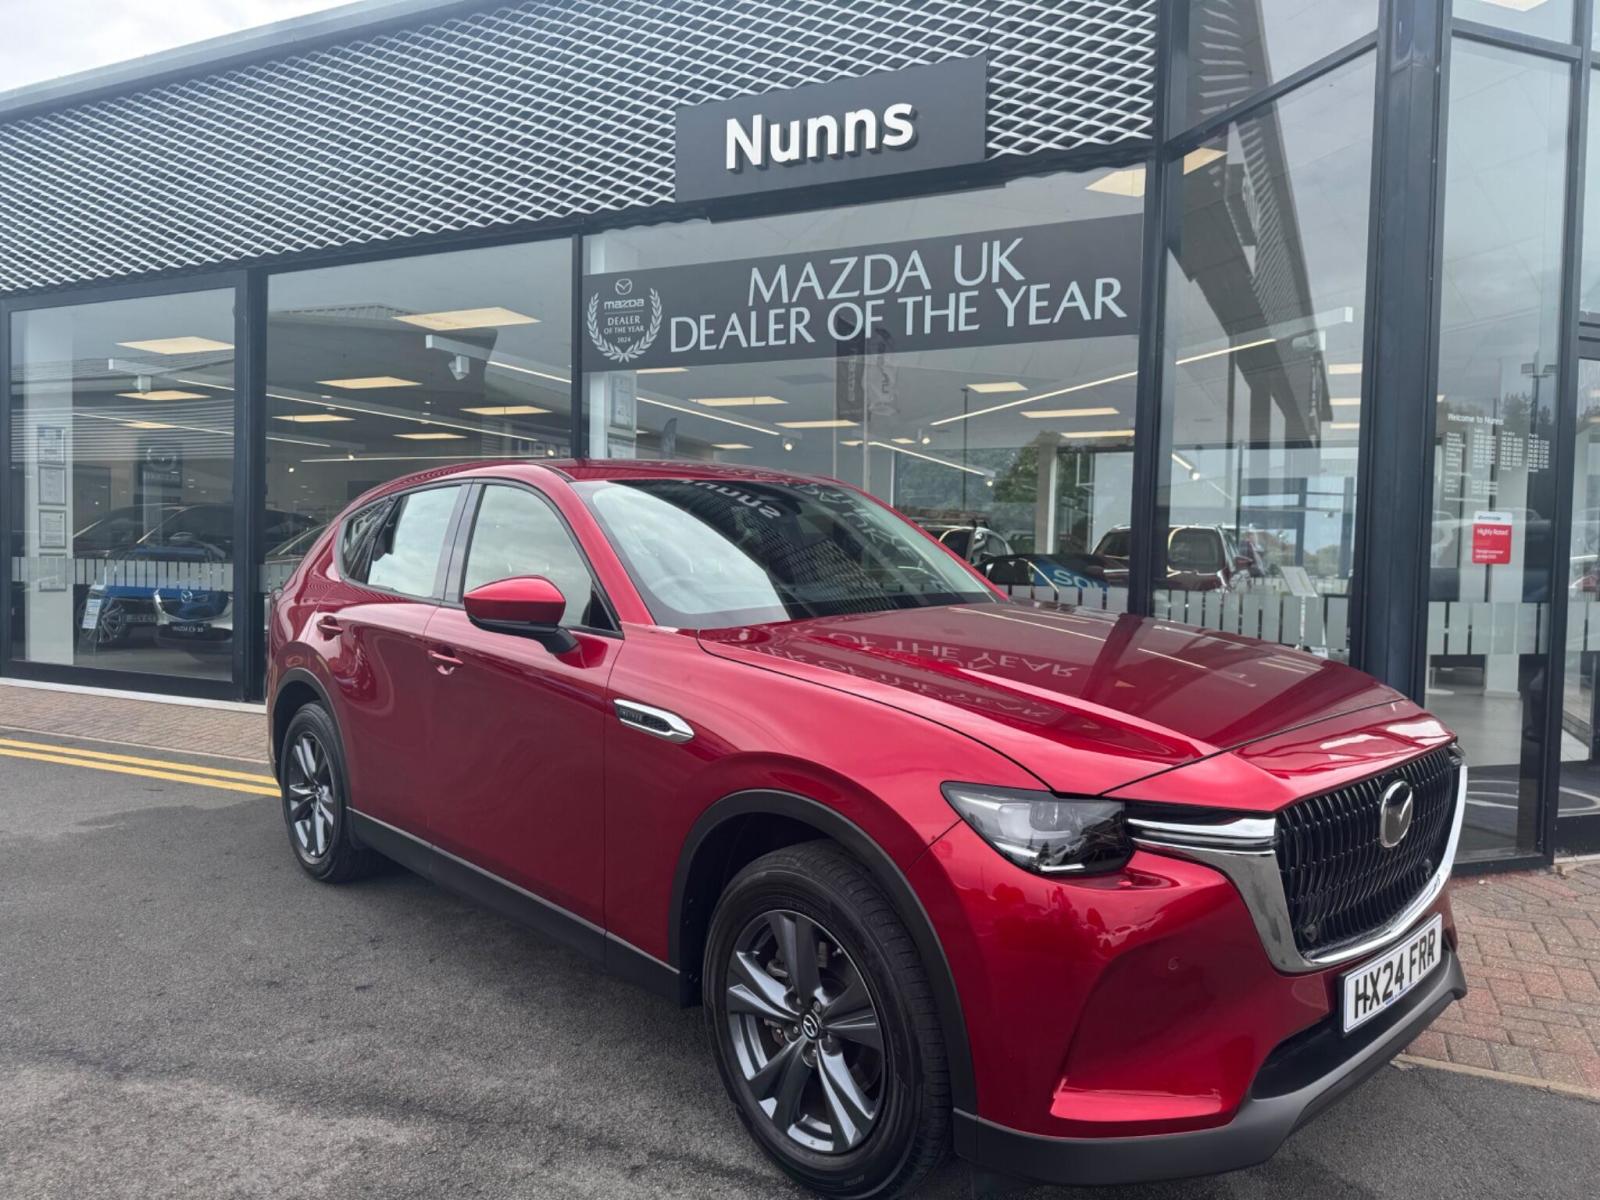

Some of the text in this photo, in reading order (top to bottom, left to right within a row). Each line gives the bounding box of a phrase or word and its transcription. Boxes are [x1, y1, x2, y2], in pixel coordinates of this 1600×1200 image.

[725, 102, 914, 170] Nunns
[604, 298, 645, 310] mazda
[748, 238, 1025, 306] MAZDA UK
[603, 325, 645, 335] OF THE YEAR
[607, 315, 641, 326] DEALER
[670, 278, 1127, 353] DEALER OF THE YEAR
[1355, 928, 1436, 1018] HX24 FRR
